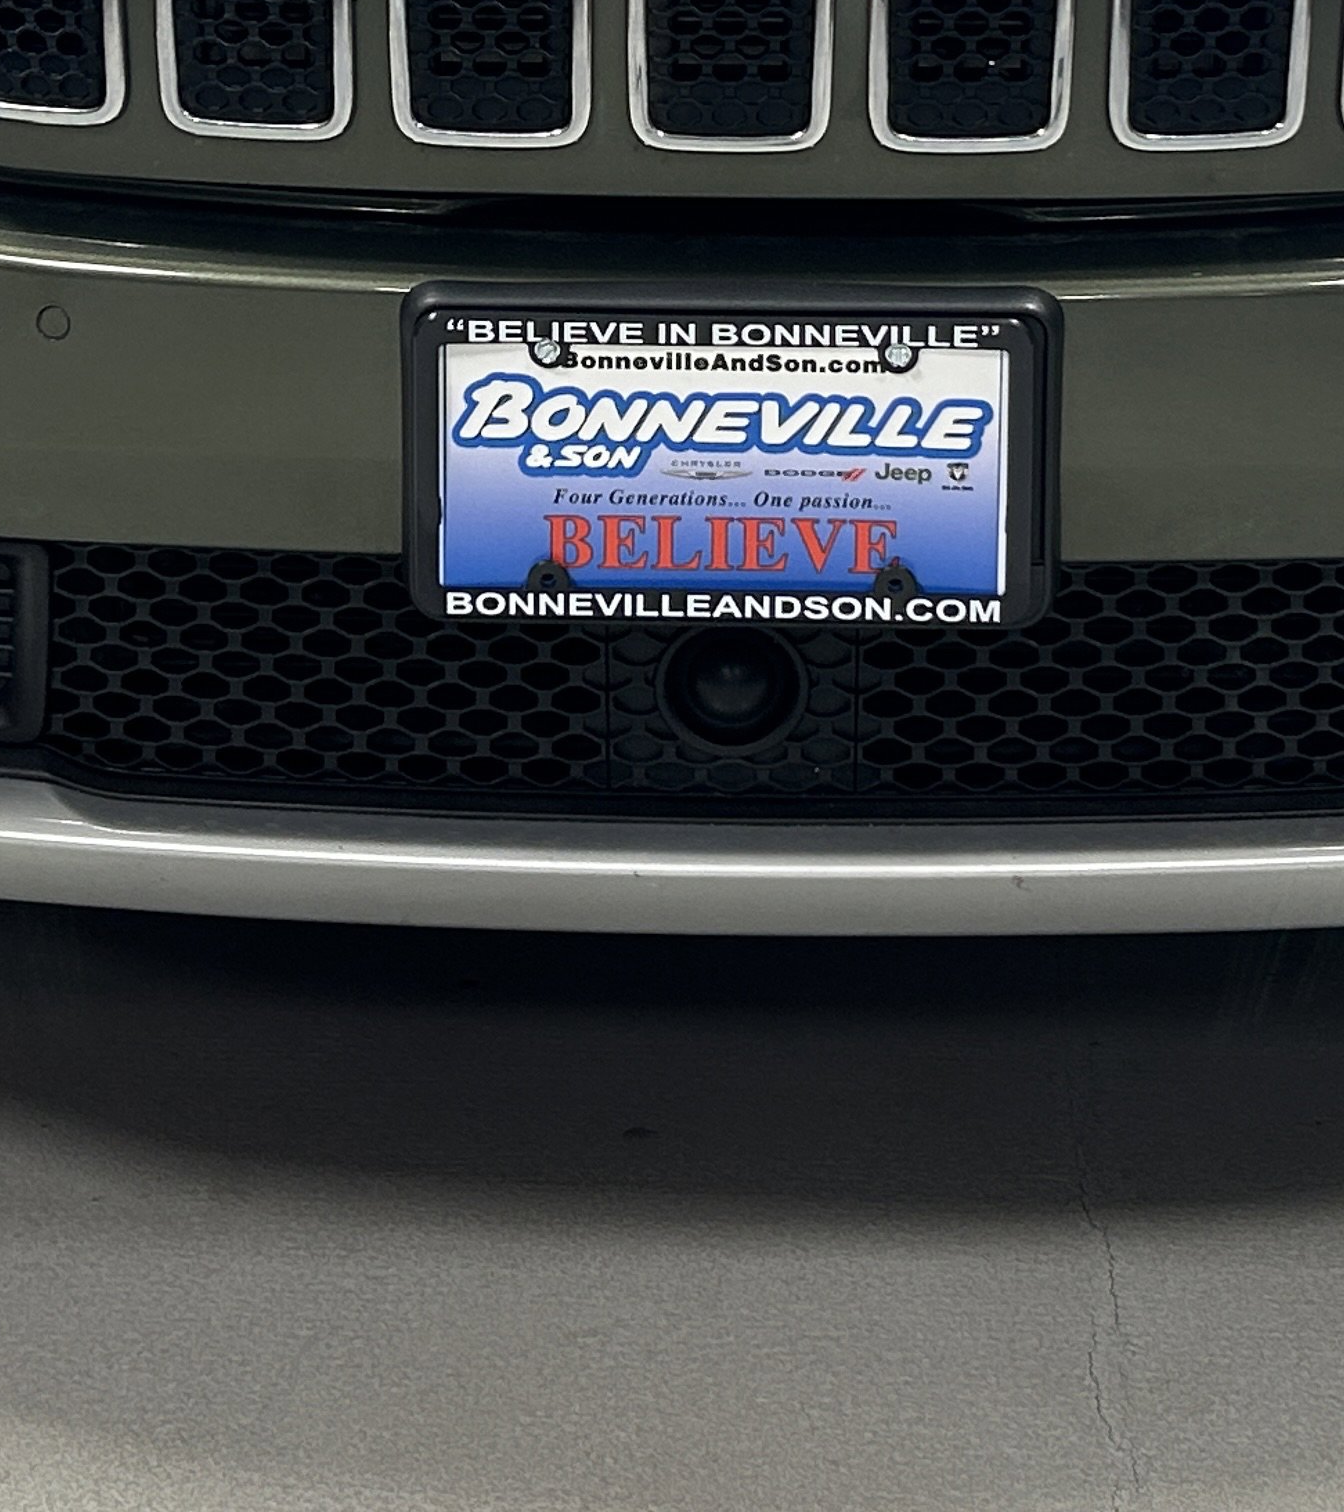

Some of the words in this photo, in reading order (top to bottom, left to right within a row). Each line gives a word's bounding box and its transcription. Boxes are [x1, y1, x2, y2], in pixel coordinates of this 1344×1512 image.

[657, 322, 697, 345] IN
[564, 351, 886, 373] BonnevilleAndSon.com
[458, 378, 984, 451] BONNEVILLE
[874, 462, 932, 485] Jeep
[552, 488, 603, 505] Four
[753, 491, 794, 508] One
[543, 514, 900, 575] BELIEVE
[445, 591, 1001, 624] BONNEVILLEANDSON.COM
